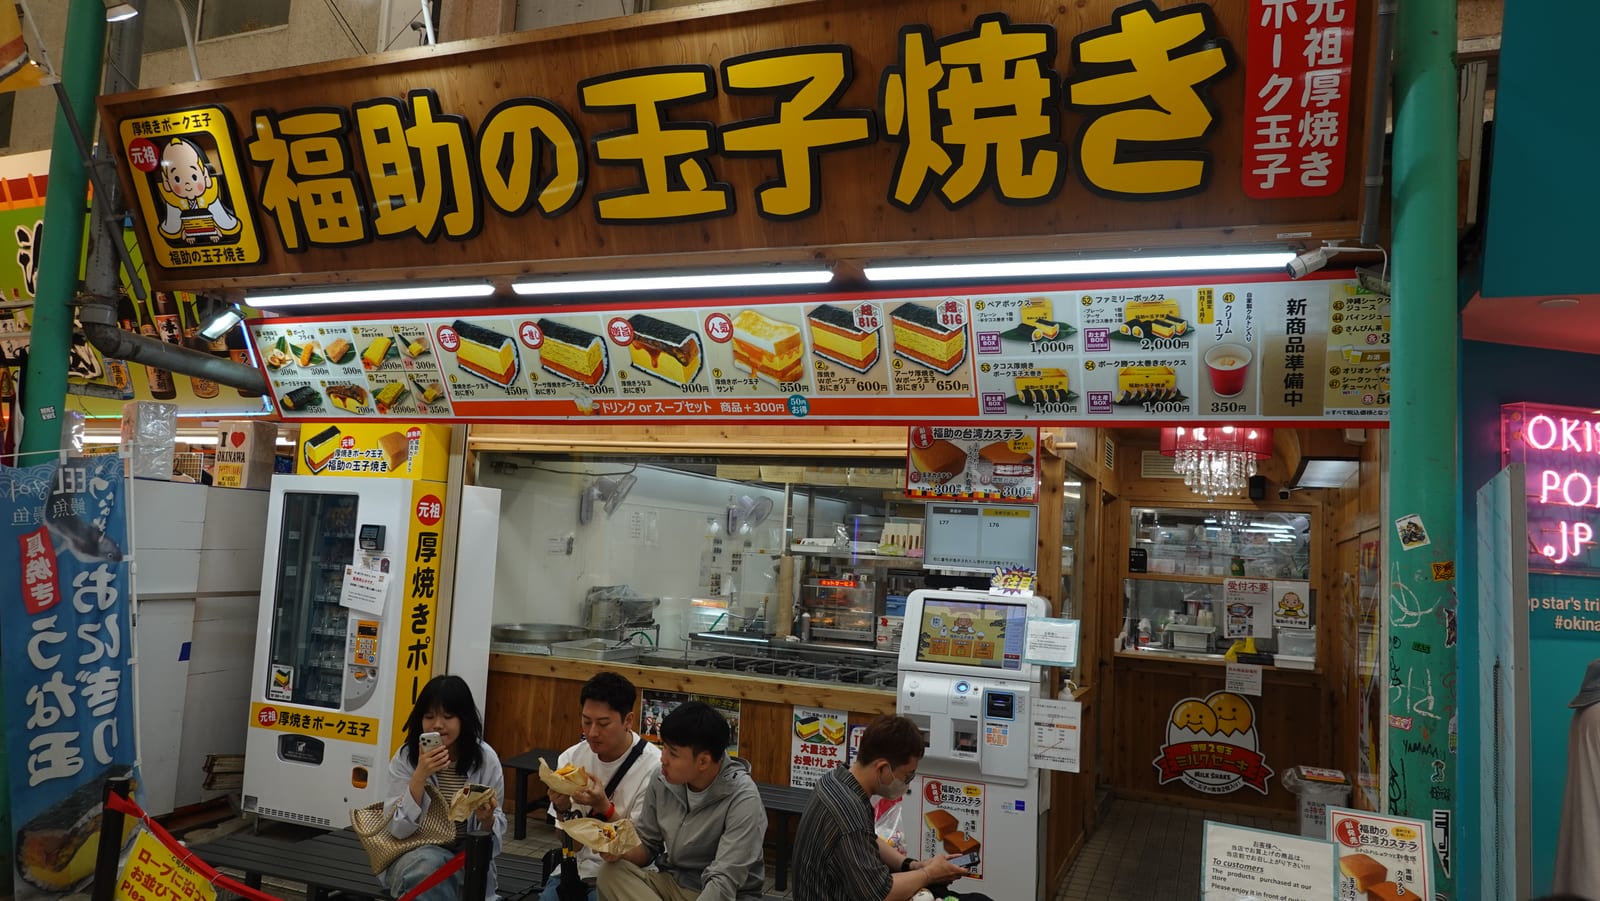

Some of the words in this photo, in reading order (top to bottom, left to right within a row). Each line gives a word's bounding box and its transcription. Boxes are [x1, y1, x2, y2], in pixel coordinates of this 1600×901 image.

[132, 113, 212, 136] 厚焼きポーク玉子
[248, 3, 1231, 252] 福助の玉子焼き
[130, 146, 156, 165] 元祖
[169, 248, 246, 265] 福助の玉子焼き
[1095, 294, 1165, 304] ファミリーボックス
[861, 304, 873, 316] 超
[945, 301, 957, 313] 超
[1346, 304, 1377, 312] ジュース
[858, 317, 878, 328] BIG
[942, 314, 963, 325] BIG
[1225, 304, 1233, 334] クリーム
[710, 321, 731, 333] 人気
[1215, 319, 1224, 341] スープ
[1030, 342, 1074, 353] 1,000円
[1141, 338, 1189, 350] 2,000円
[1283, 298, 1308, 407] 新商品準備中
[504, 386, 529, 395] 450円
[588, 384, 615, 394] 500円
[623, 386, 646, 394] おにぎり
[681, 383, 709, 393] 900円
[716, 385, 735, 393] サンド
[779, 381, 809, 392] 550円
[819, 384, 847, 392] おにぎり
[856, 381, 888, 392] 600円
[895, 383, 926, 391] おにぎり
[936, 380, 969, 391] 650円
[790, 396, 807, 406] 50円
[602, 402, 637, 414] ドリンク
[639, 403, 652, 413] or
[654, 401, 712, 414] スープセット
[791, 405, 808, 415] お得
[1033, 402, 1077, 414] 1,000円
[1142, 401, 1190, 414] 1,000円
[1211, 402, 1247, 413] 350円
[221, 431, 228, 447] I
[934, 428, 1024, 440] 福助の台湾カステラ
[340, 437, 355, 449] 元祖
[217, 451, 246, 464] OKINAWA
[334, 449, 384, 460] 厚焼きポーク玉子
[327, 459, 389, 473] 福助の玉子焼き
[1541, 470, 1600, 508] PO
[417, 500, 441, 519] 元祖
[1543, 521, 1593, 563] .JP
[1227, 580, 1269, 592] 受付不要
[1542, 598, 1581, 611] star's
[259, 710, 278, 723] 元祖
[278, 711, 371, 738] 厚焼きポーク玉子
[800, 743, 838, 757] 大量注文
[1176, 754, 1249, 771] ミルクセーキ
[1194, 771, 1210, 779] MILK
[941, 785, 962, 795] 福助の
[941, 794, 982, 806] 台湾カステラ
[1359, 823, 1388, 835] 福助の
[1360, 835, 1418, 851] 台湾カステラ
[1213, 857, 1222, 866] To
[1223, 861, 1265, 873] customers
[1211, 874, 1227, 882] store
[1212, 867, 1223, 875] The
[1227, 871, 1256, 881] products
[1259, 876, 1292, 887] purchased
[1211, 882, 1231, 891] Please
[1231, 887, 1249, 896] enjoy
[1263, 891, 1279, 900] front
[1280, 893, 1287, 901] of
